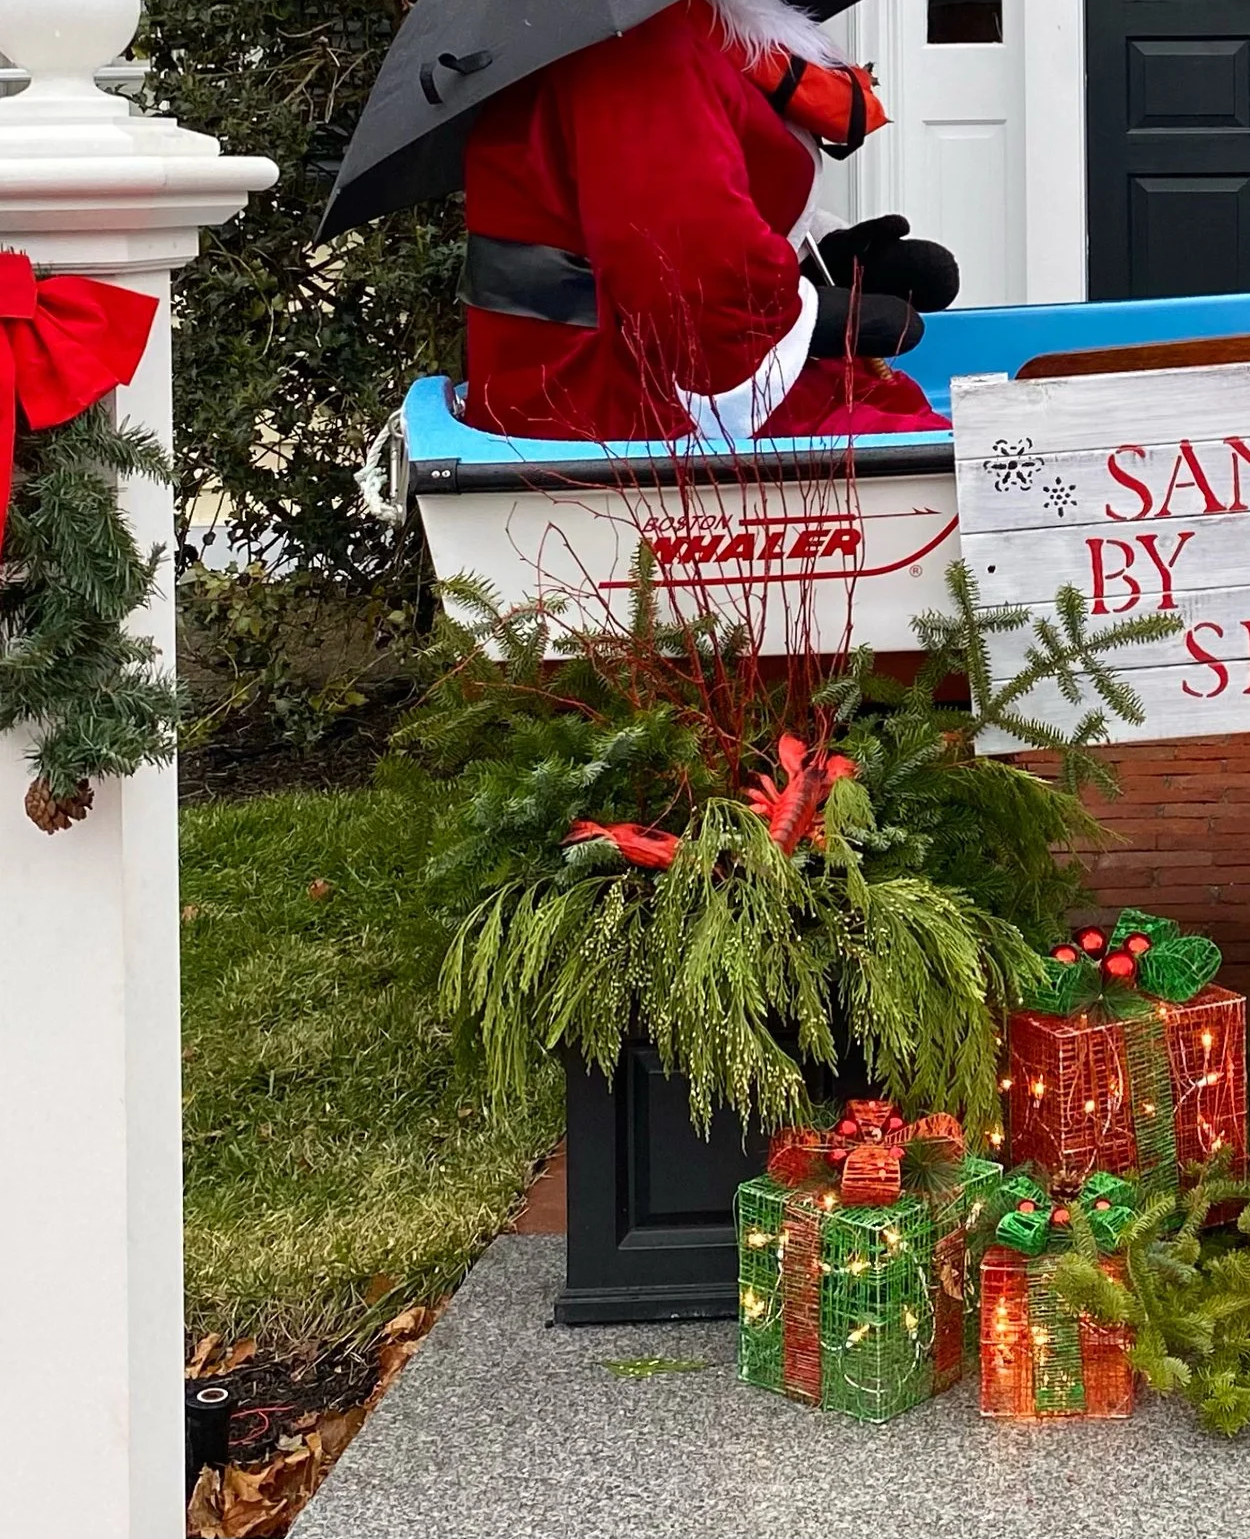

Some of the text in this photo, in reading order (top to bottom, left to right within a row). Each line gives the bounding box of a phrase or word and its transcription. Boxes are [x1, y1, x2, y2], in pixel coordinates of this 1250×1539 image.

[641, 514, 733, 533] BOSTON
[650, 528, 862, 565] WHALER
[1085, 531, 1195, 616] BY
